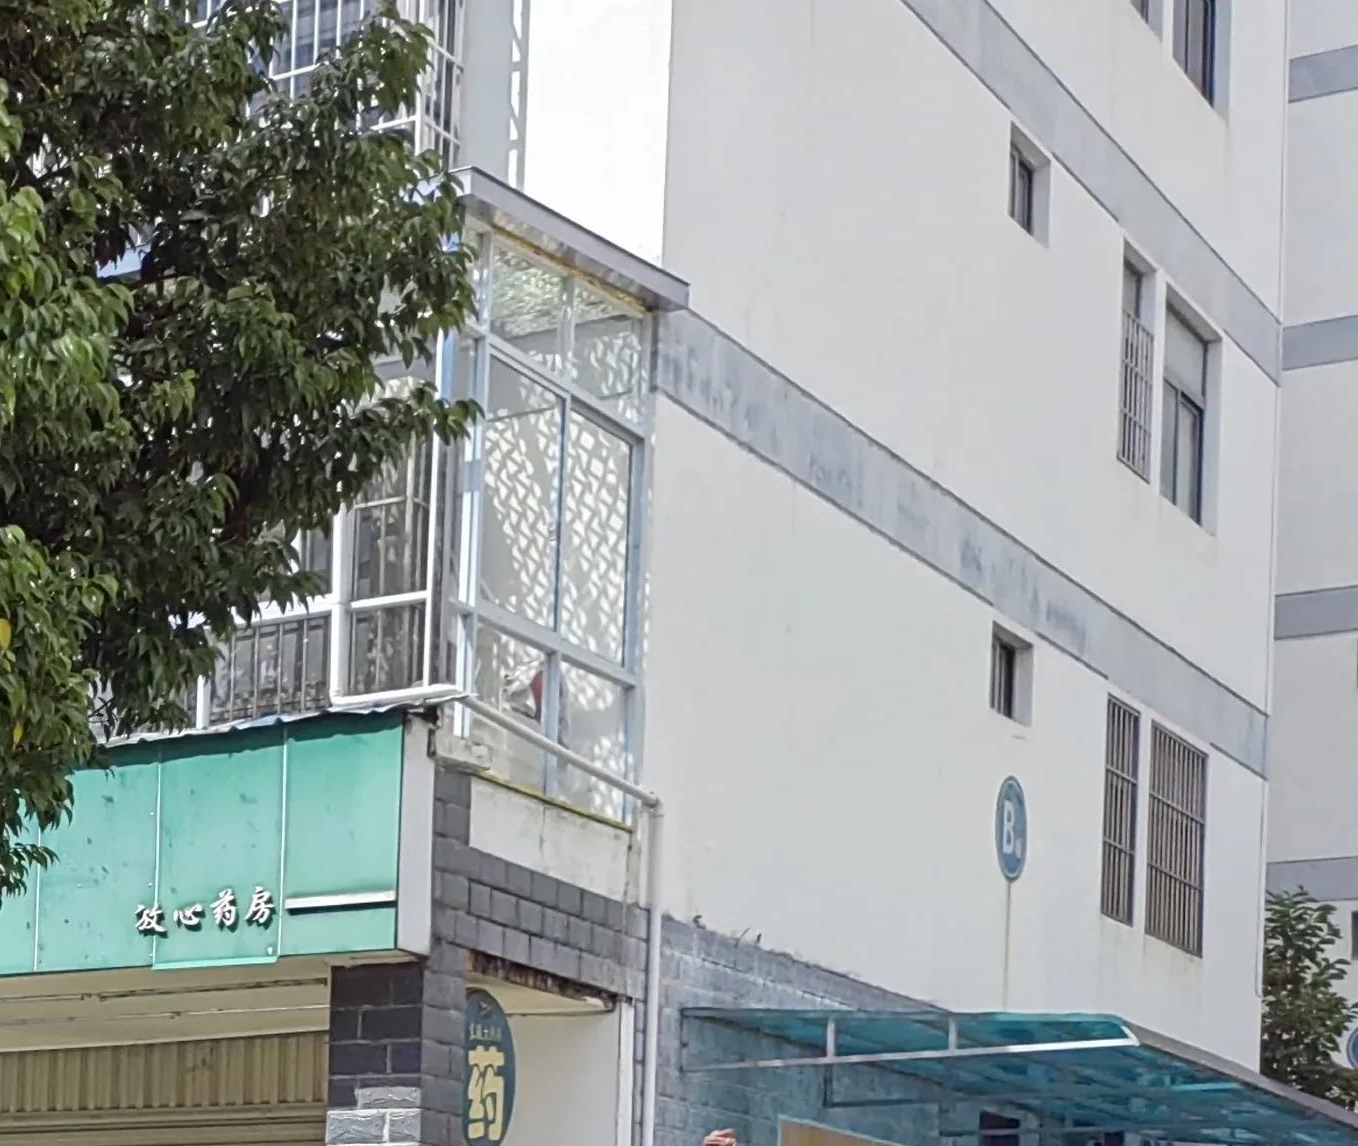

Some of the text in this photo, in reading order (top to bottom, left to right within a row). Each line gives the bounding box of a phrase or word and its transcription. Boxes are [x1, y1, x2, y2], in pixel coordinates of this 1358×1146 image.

[134, 885, 276, 934] 放心药房
[468, 1045, 505, 1141] 药
